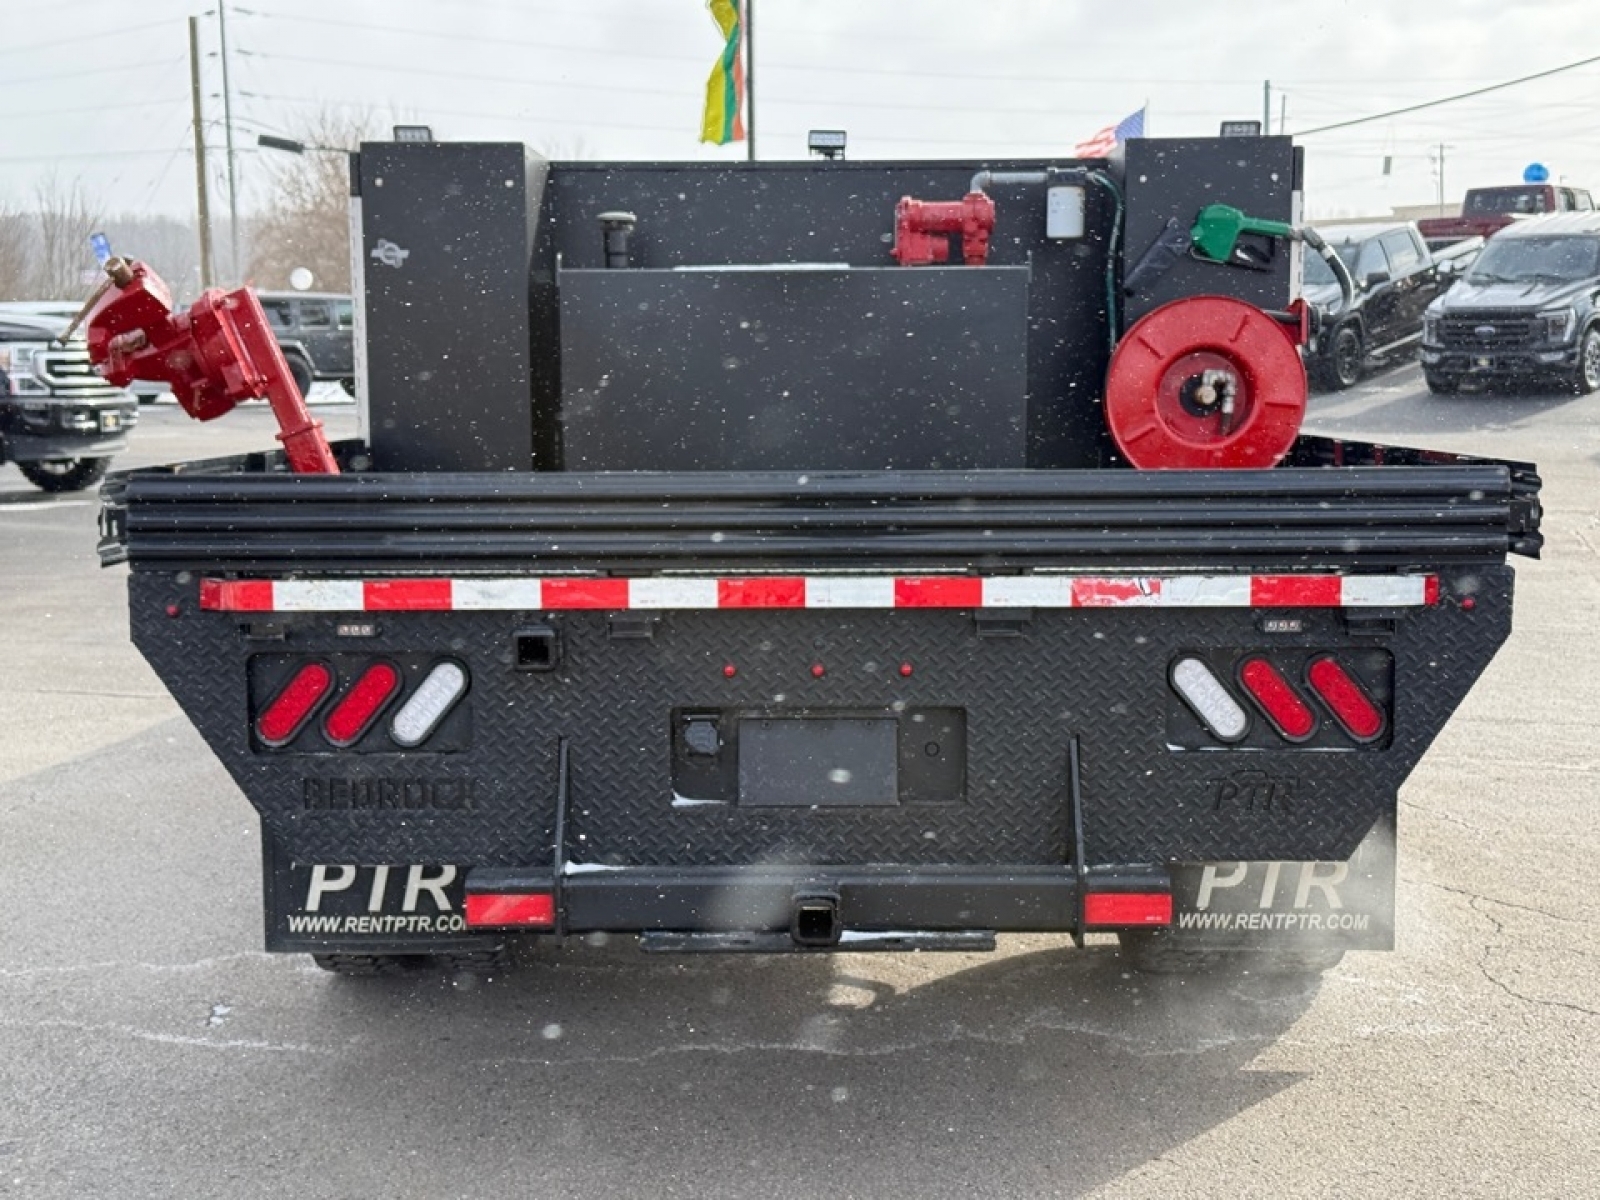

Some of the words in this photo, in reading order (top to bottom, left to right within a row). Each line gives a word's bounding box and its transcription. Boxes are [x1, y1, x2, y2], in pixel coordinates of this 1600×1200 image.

[305, 864, 457, 912] PTR
[288, 915, 467, 933] WWW.RENTPTR.CO
[1179, 912, 1370, 931] WWW.RENTPTR.COM
